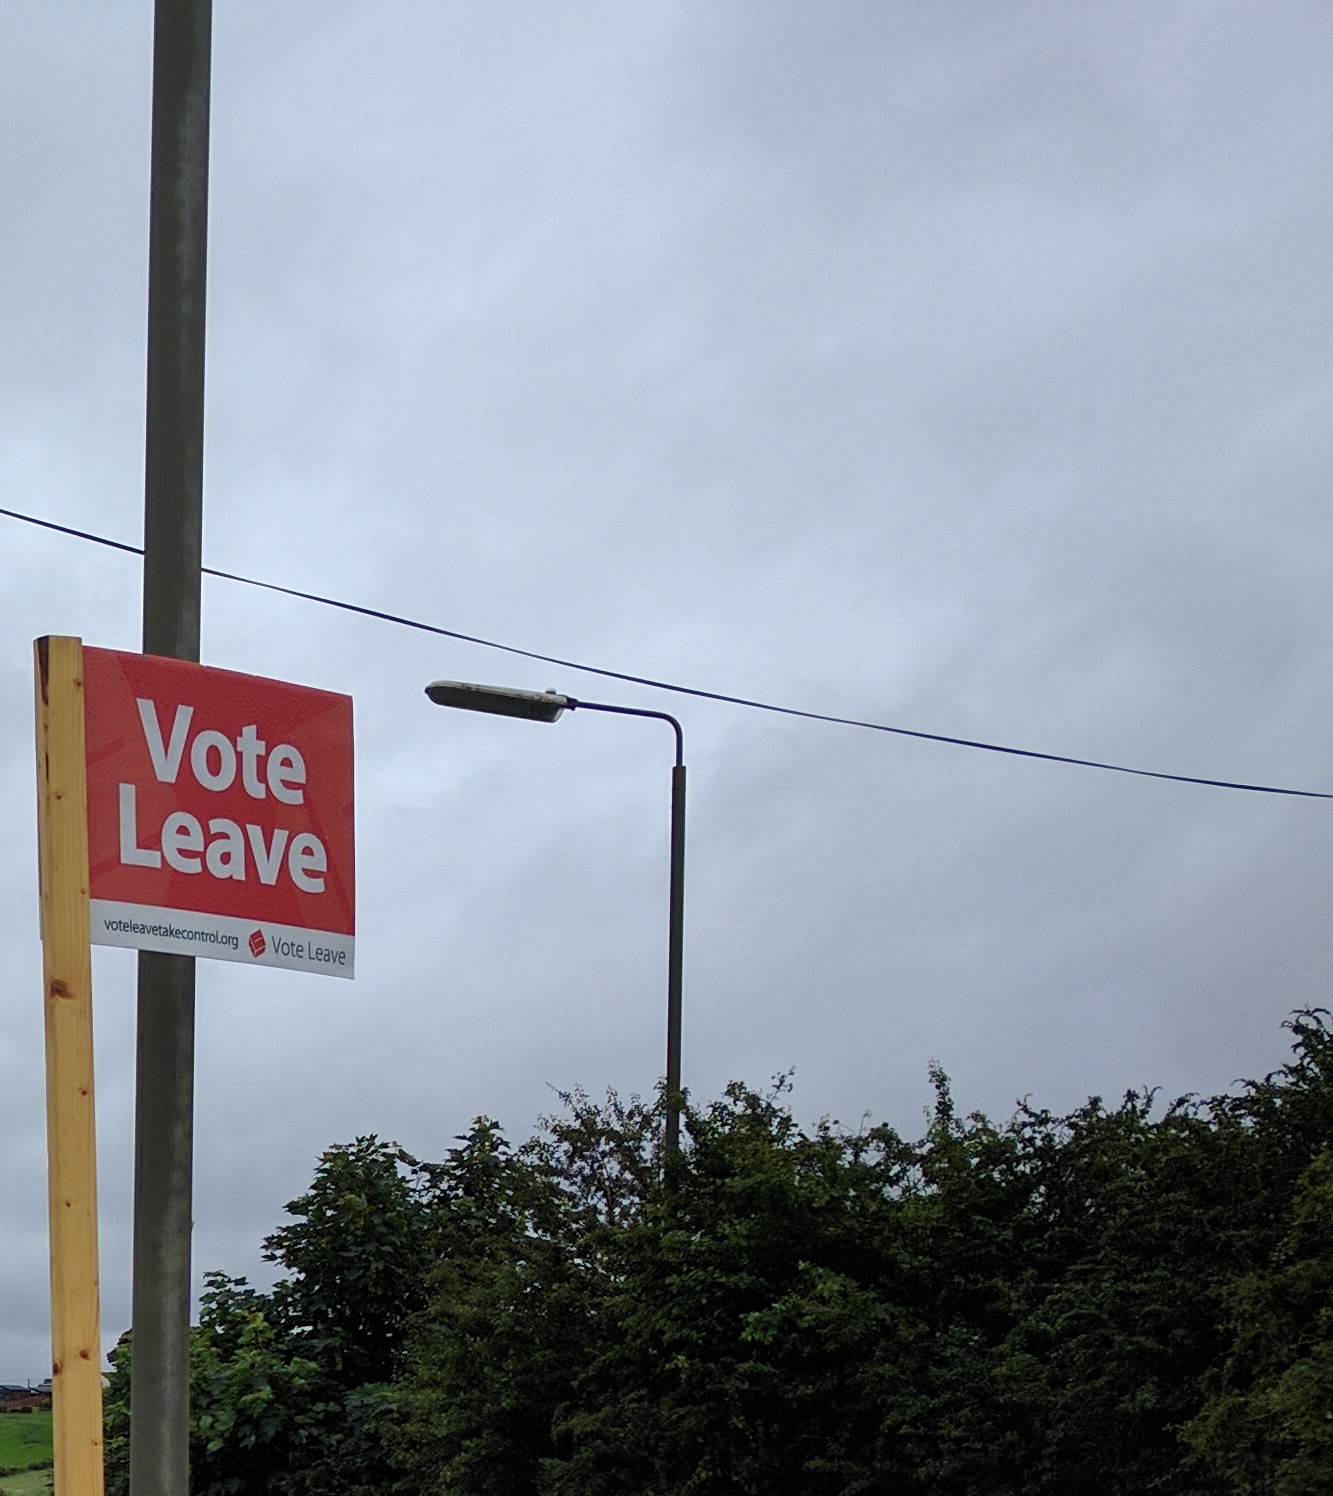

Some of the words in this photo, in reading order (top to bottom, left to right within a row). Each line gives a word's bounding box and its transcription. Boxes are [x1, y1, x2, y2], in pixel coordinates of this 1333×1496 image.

[136, 698, 306, 805] Vote
[119, 783, 327, 893] Leave
[104, 918, 239, 949] voteleavetakecontrol.org
[272, 936, 304, 958] Vote
[308, 942, 346, 965] Leave
